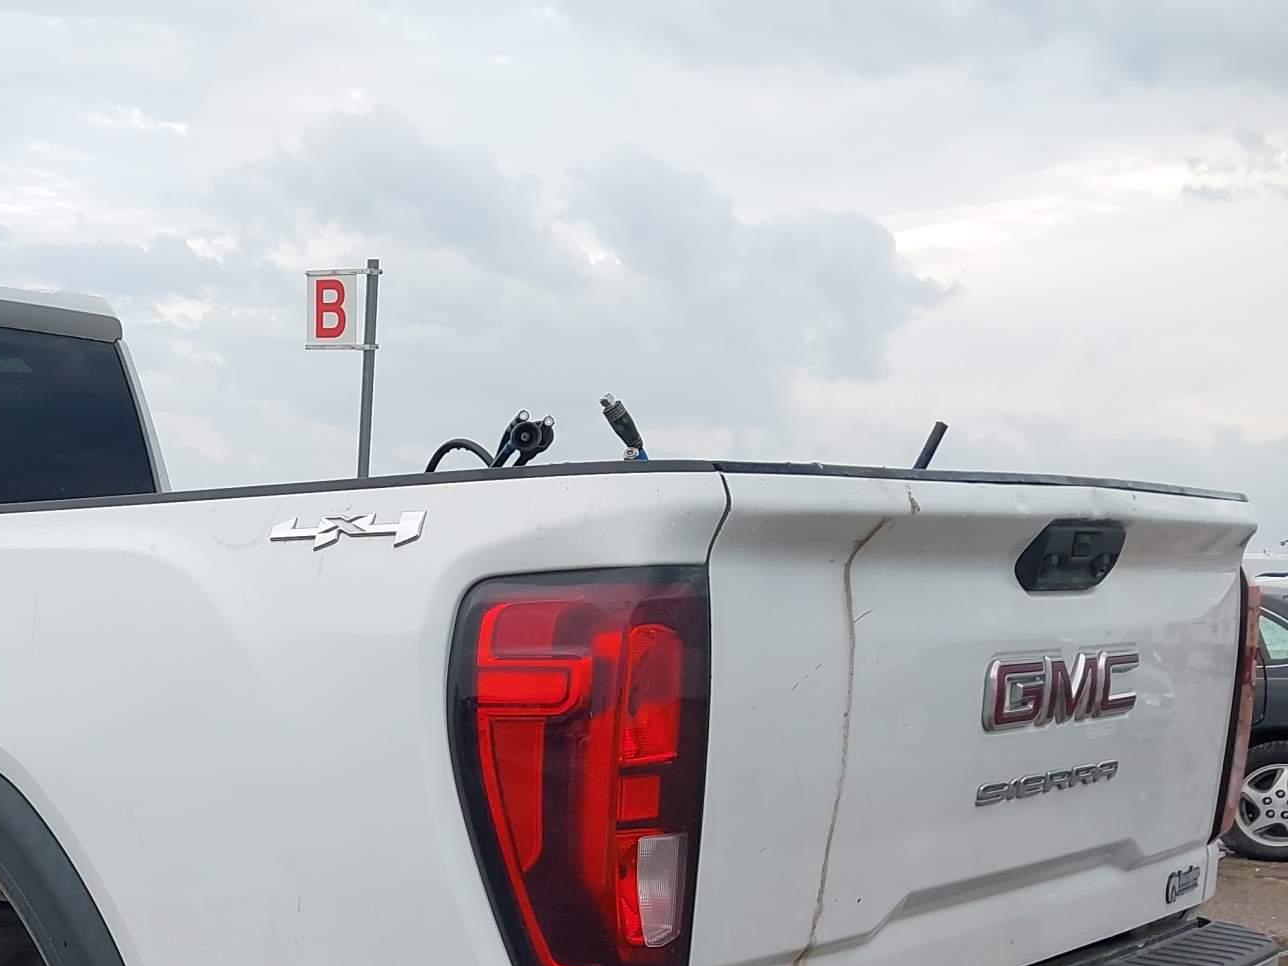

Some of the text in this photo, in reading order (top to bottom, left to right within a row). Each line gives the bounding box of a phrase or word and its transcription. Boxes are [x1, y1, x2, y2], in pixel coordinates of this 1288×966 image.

[315, 279, 347, 339] B
[982, 651, 1140, 732] GMC
[974, 759, 1120, 807] SIERRA
